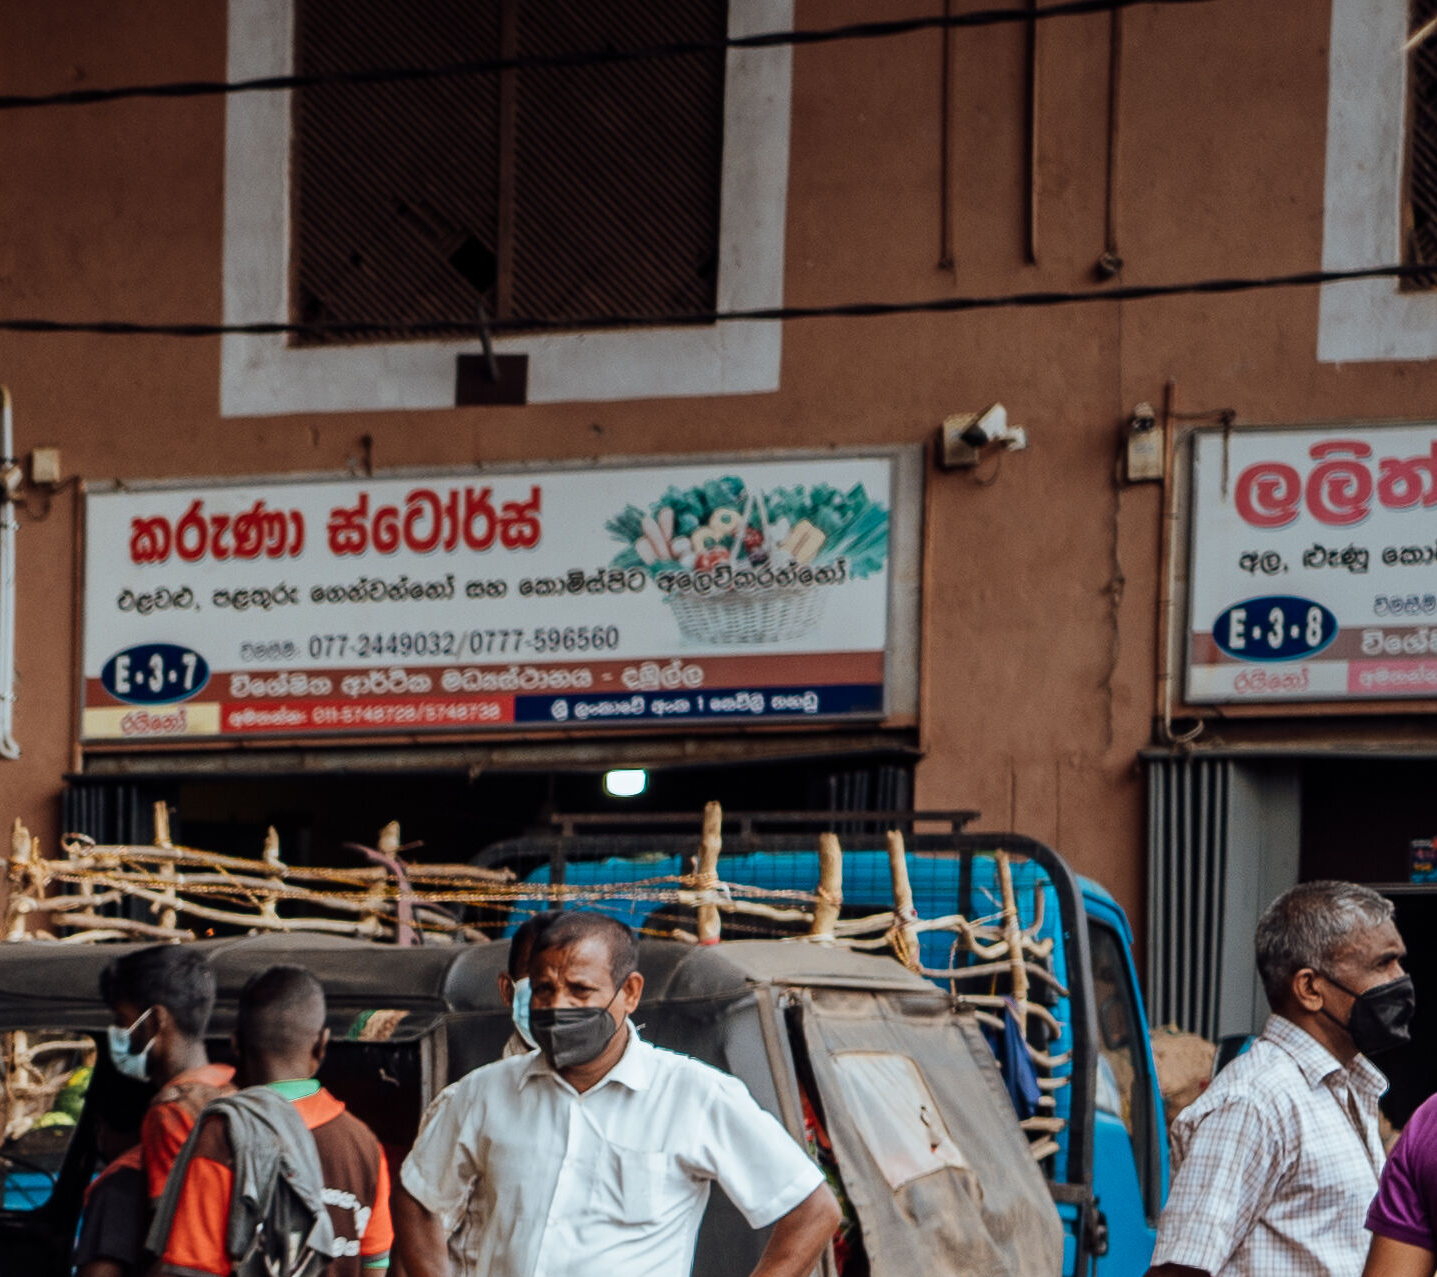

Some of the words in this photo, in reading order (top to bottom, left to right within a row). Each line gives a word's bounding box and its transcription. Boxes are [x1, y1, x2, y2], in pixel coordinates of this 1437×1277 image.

[129, 499, 306, 564] කරුණා
[326, 486, 545, 557] ස්ටෝර්ස්
[308, 625, 620, 661] 077-2449032/0777-596560
